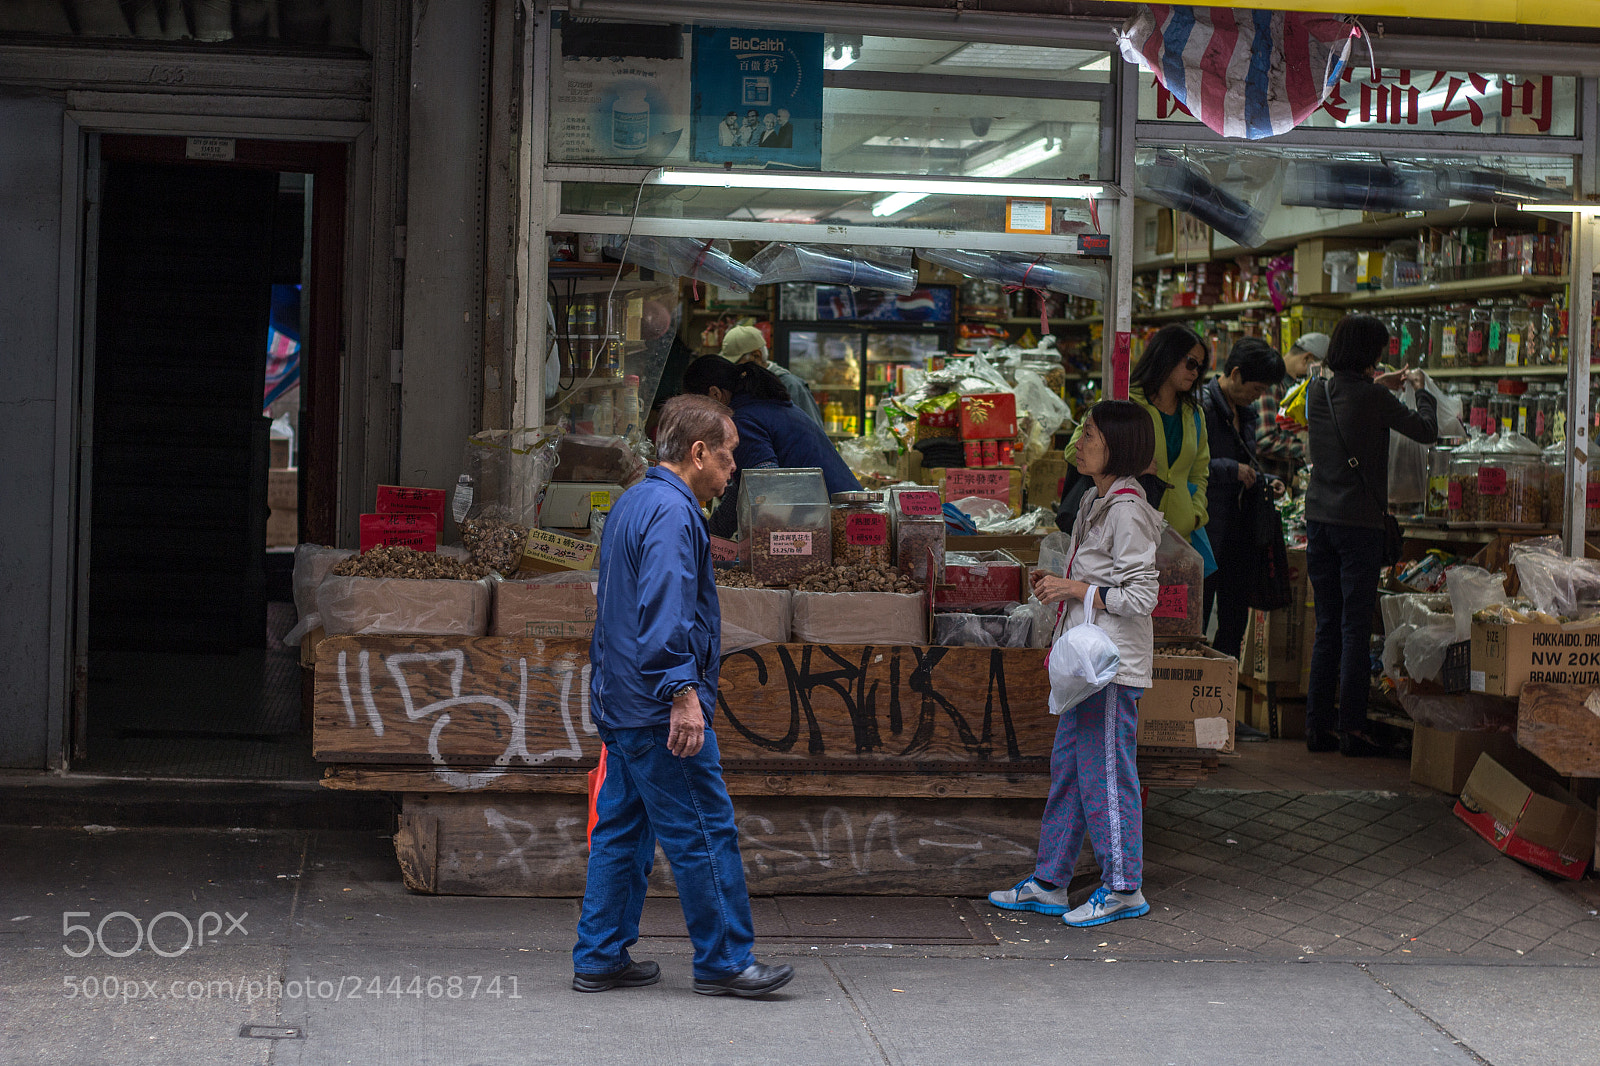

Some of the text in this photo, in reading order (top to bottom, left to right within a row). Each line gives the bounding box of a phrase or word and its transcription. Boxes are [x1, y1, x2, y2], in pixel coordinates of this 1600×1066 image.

[730, 37, 784, 51] BioCalth
[1486, 630, 1499, 643] SIZE
[1531, 652, 1563, 666] NW
[1192, 685, 1222, 698] SIZE
